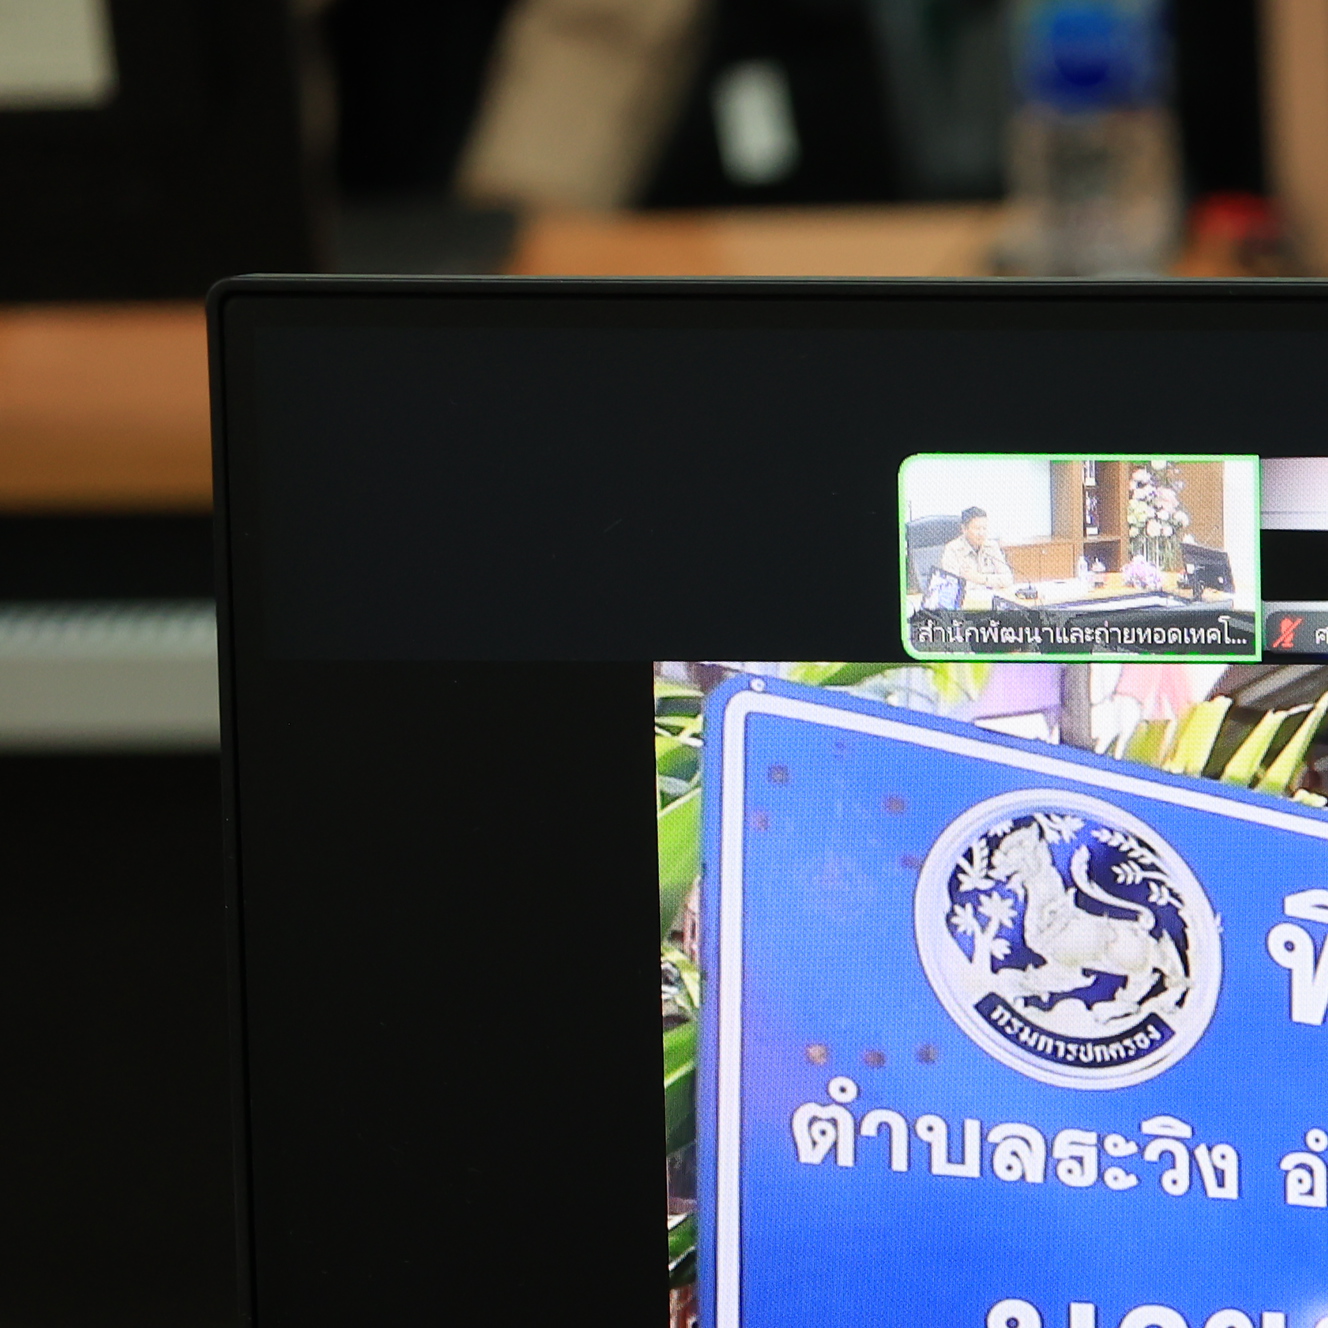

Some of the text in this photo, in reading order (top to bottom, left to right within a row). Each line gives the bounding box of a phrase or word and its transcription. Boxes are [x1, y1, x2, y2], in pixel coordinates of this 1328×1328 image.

[989, 1005, 1162, 1064] กรมการปกครอง
[791, 1076, 1240, 1201] ตำบลระวิง
